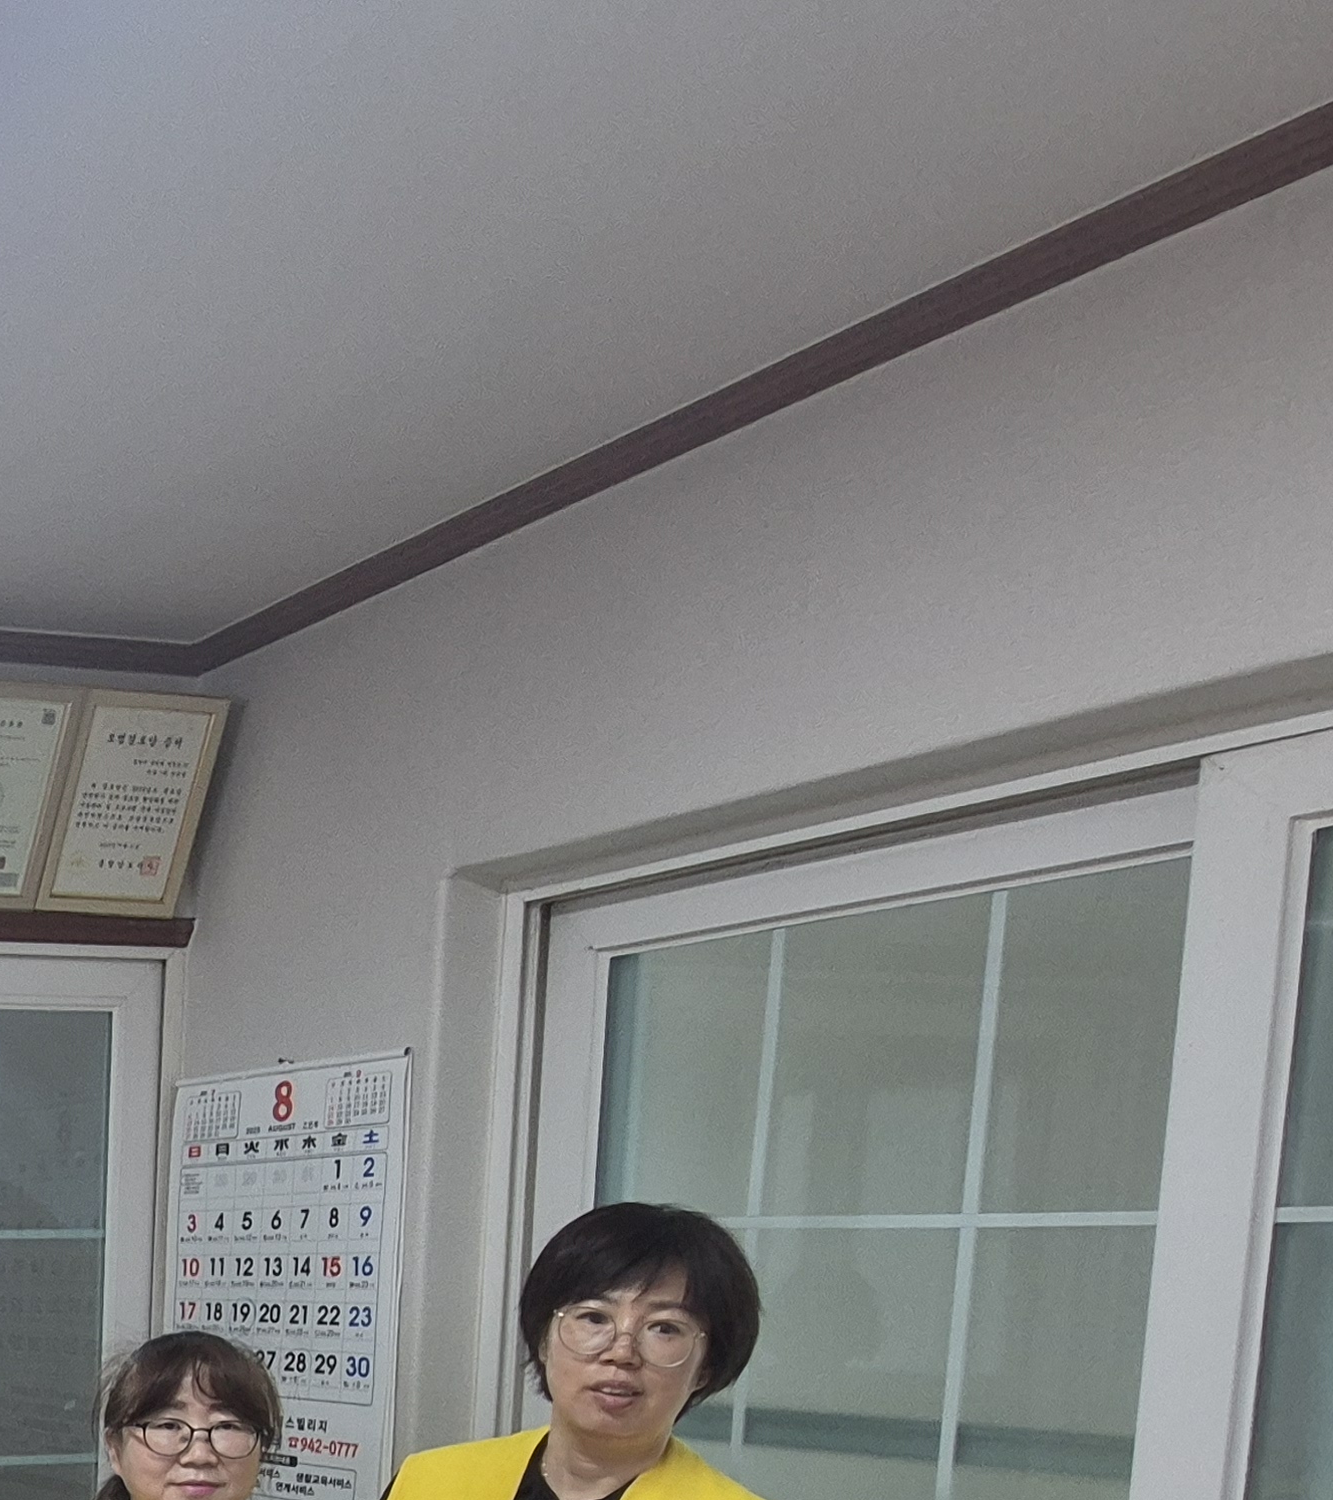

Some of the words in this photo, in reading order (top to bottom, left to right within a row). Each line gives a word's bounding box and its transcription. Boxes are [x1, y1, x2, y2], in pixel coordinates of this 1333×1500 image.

[272, 1080, 293, 1121] 8
[268, 1123, 296, 1132] AUGUST
[188, 1146, 201, 1157] 日
[244, 1142, 260, 1154] 火
[274, 1138, 289, 1151] 水
[302, 1136, 317, 1149] 木
[331, 1134, 347, 1146] 金
[363, 1130, 379, 1144] 土
[334, 1160, 342, 1179] 1
[363, 1157, 375, 1177] 2
[187, 1214, 197, 1233] 3
[214, 1213, 224, 1231] 4
[241, 1212, 252, 1230] 5
[271, 1211, 282, 1229] 6
[300, 1209, 310, 1229] 7
[329, 1208, 339, 1227] 8
[360, 1206, 372, 1226] 9
[182, 1258, 200, 1276] 10
[210, 1258, 224, 1276] 11
[236, 1258, 254, 1276] 12
[264, 1257, 283, 1276] 13
[293, 1257, 311, 1276] 14
[321, 1257, 341, 1276] 15
[353, 1256, 373, 1276] 16
[179, 1302, 196, 1320] 17
[206, 1303, 223, 1321] 18
[232, 1303, 251, 1323] 19
[259, 1304, 281, 1324] 20
[290, 1305, 307, 1325] 21
[318, 1306, 341, 1326] 22
[349, 1307, 372, 1327] 23
[284, 1353, 306, 1373] 28
[315, 1355, 337, 1375] 29
[346, 1357, 370, 1377] 30
[301, 1436, 359, 1458] 942-0777
